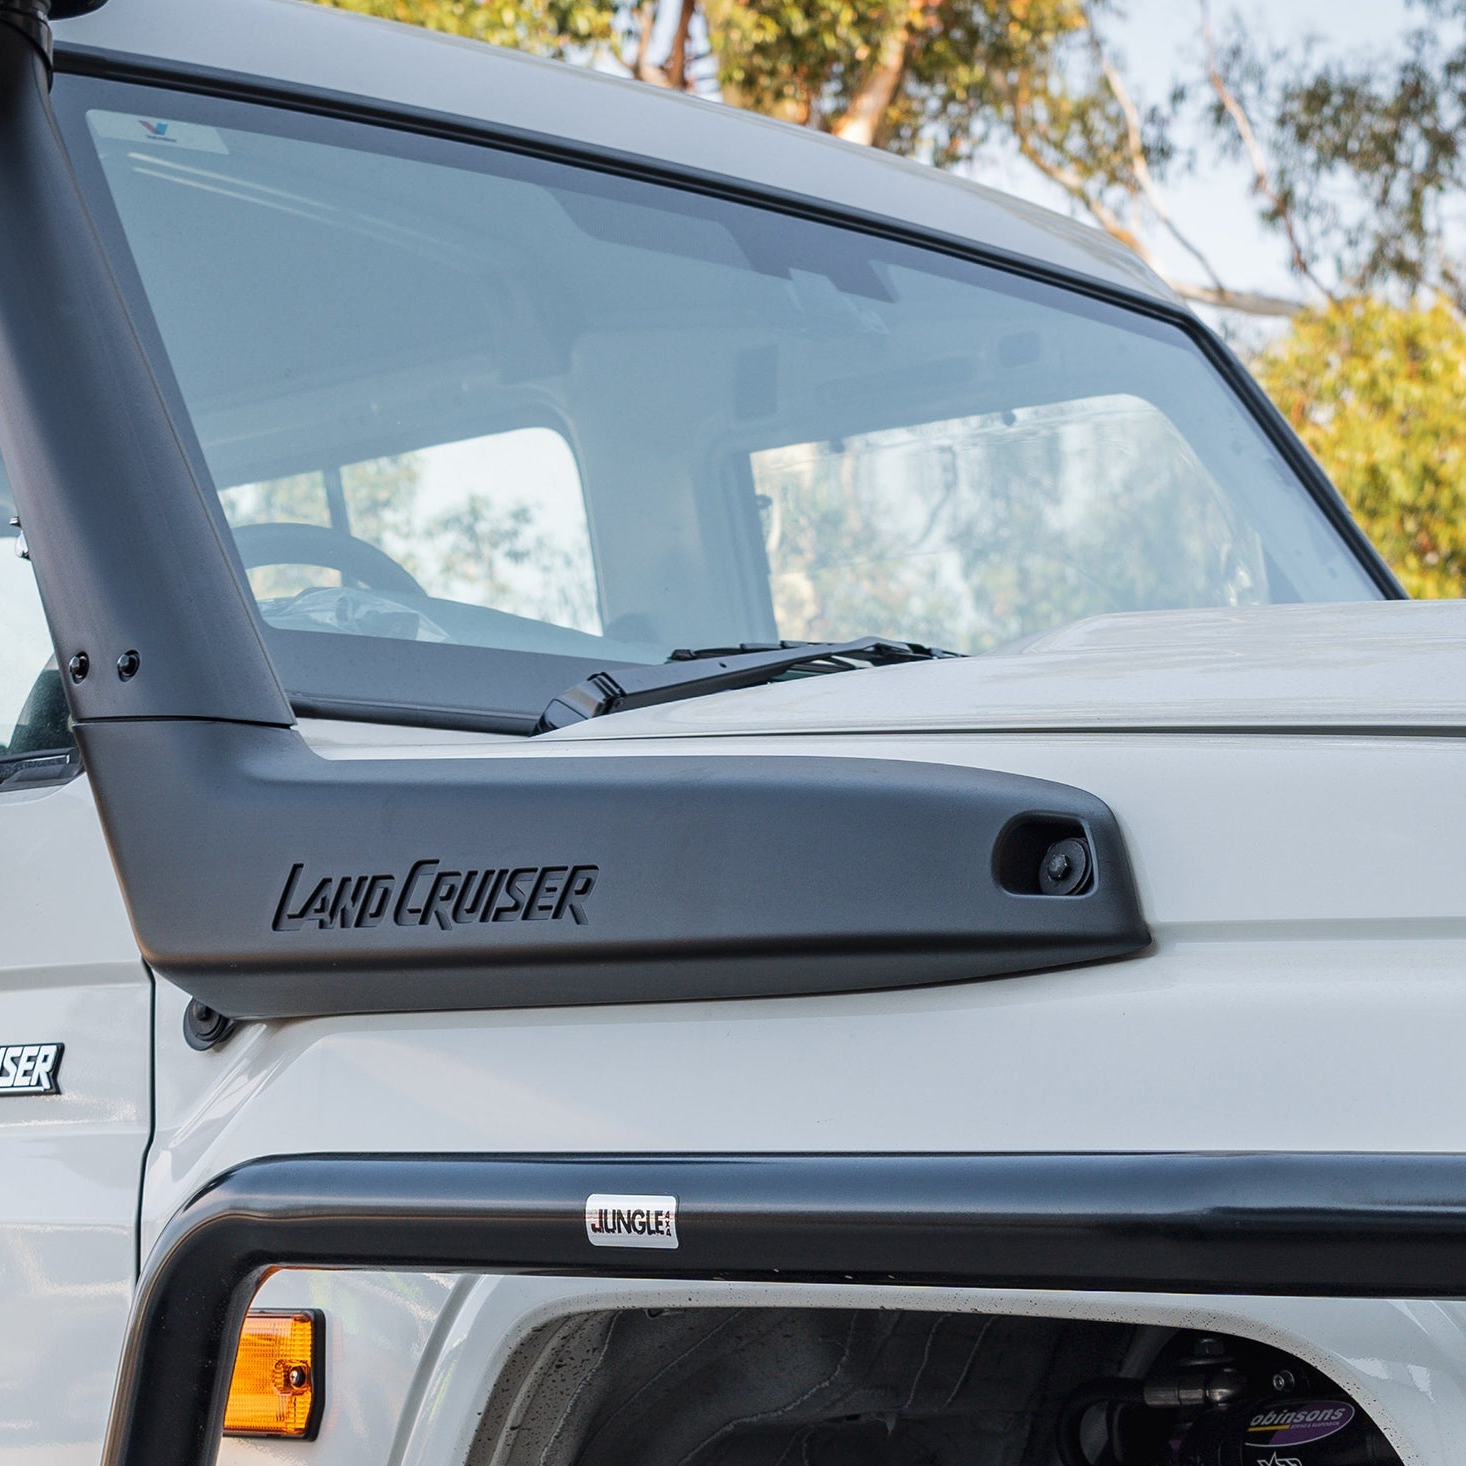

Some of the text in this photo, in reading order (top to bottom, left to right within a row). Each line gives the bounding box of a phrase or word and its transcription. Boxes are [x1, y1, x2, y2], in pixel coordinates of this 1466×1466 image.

[271, 859, 599, 931] LAND CRUISER
[591, 1208, 664, 1235] JUNGLE
[1250, 1408, 1346, 1426] obinsons
